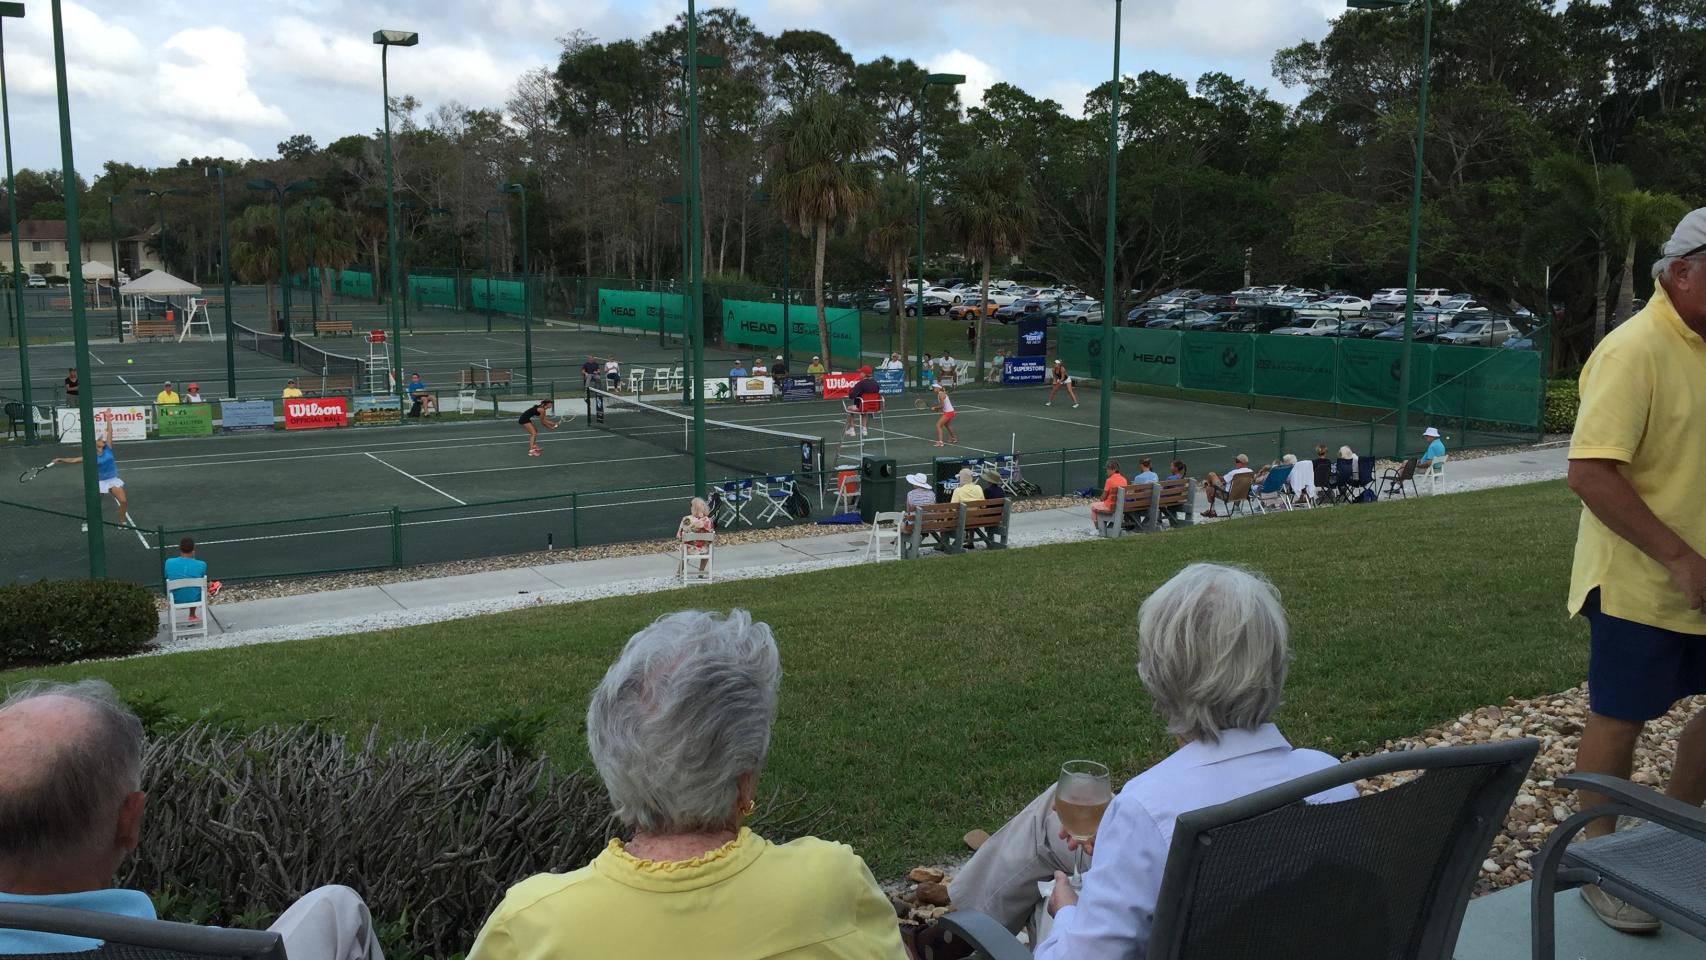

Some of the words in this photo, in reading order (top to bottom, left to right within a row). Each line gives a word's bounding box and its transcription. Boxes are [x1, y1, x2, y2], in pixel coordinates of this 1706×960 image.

[611, 306, 636, 317] HEAD
[740, 320, 777, 334] HEAD
[1133, 353, 1177, 365] HEAD
[826, 378, 860, 389] Wilso
[288, 403, 343, 417] Wilson
[290, 416, 321, 424] OFFICIAL
[943, 482, 960, 490] UST
